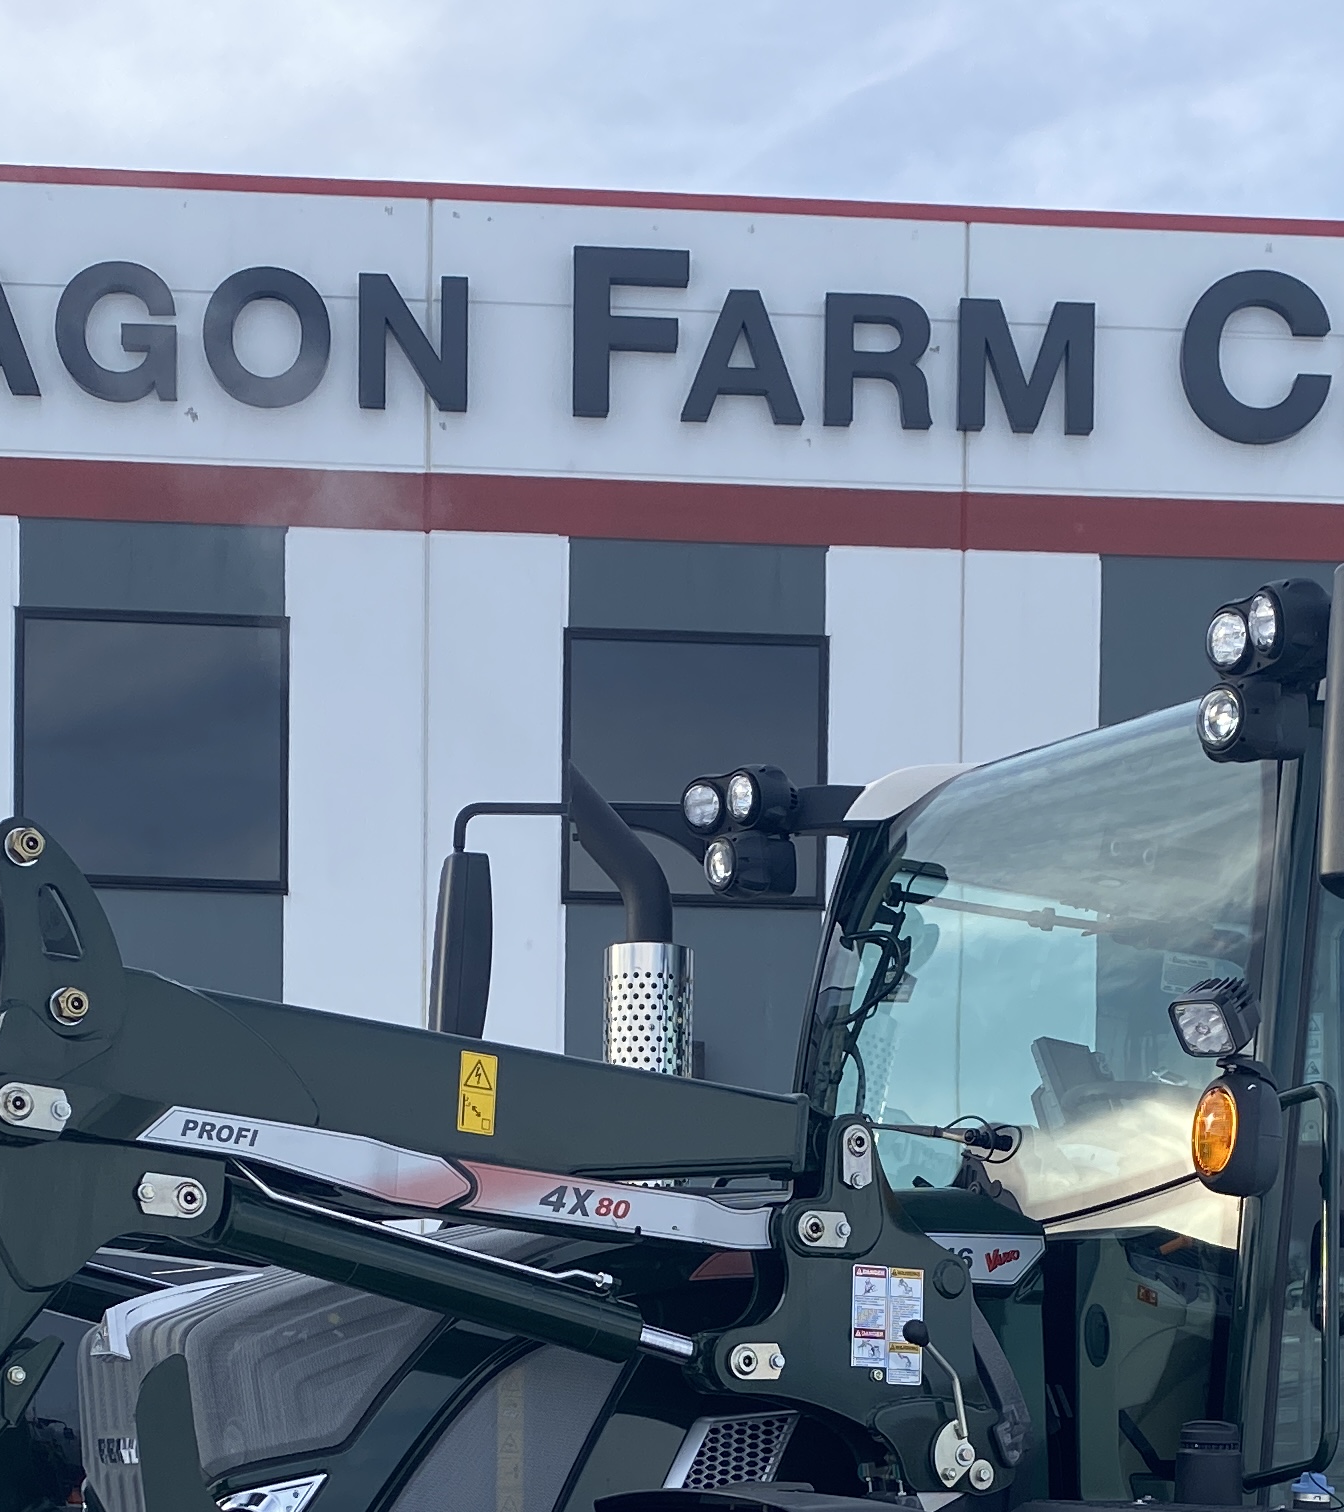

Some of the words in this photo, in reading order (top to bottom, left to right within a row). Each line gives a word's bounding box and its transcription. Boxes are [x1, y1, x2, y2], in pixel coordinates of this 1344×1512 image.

[573, 246, 1096, 437] FARM
[181, 1119, 259, 1146] PROFI
[539, 1185, 631, 1219] 4X80
